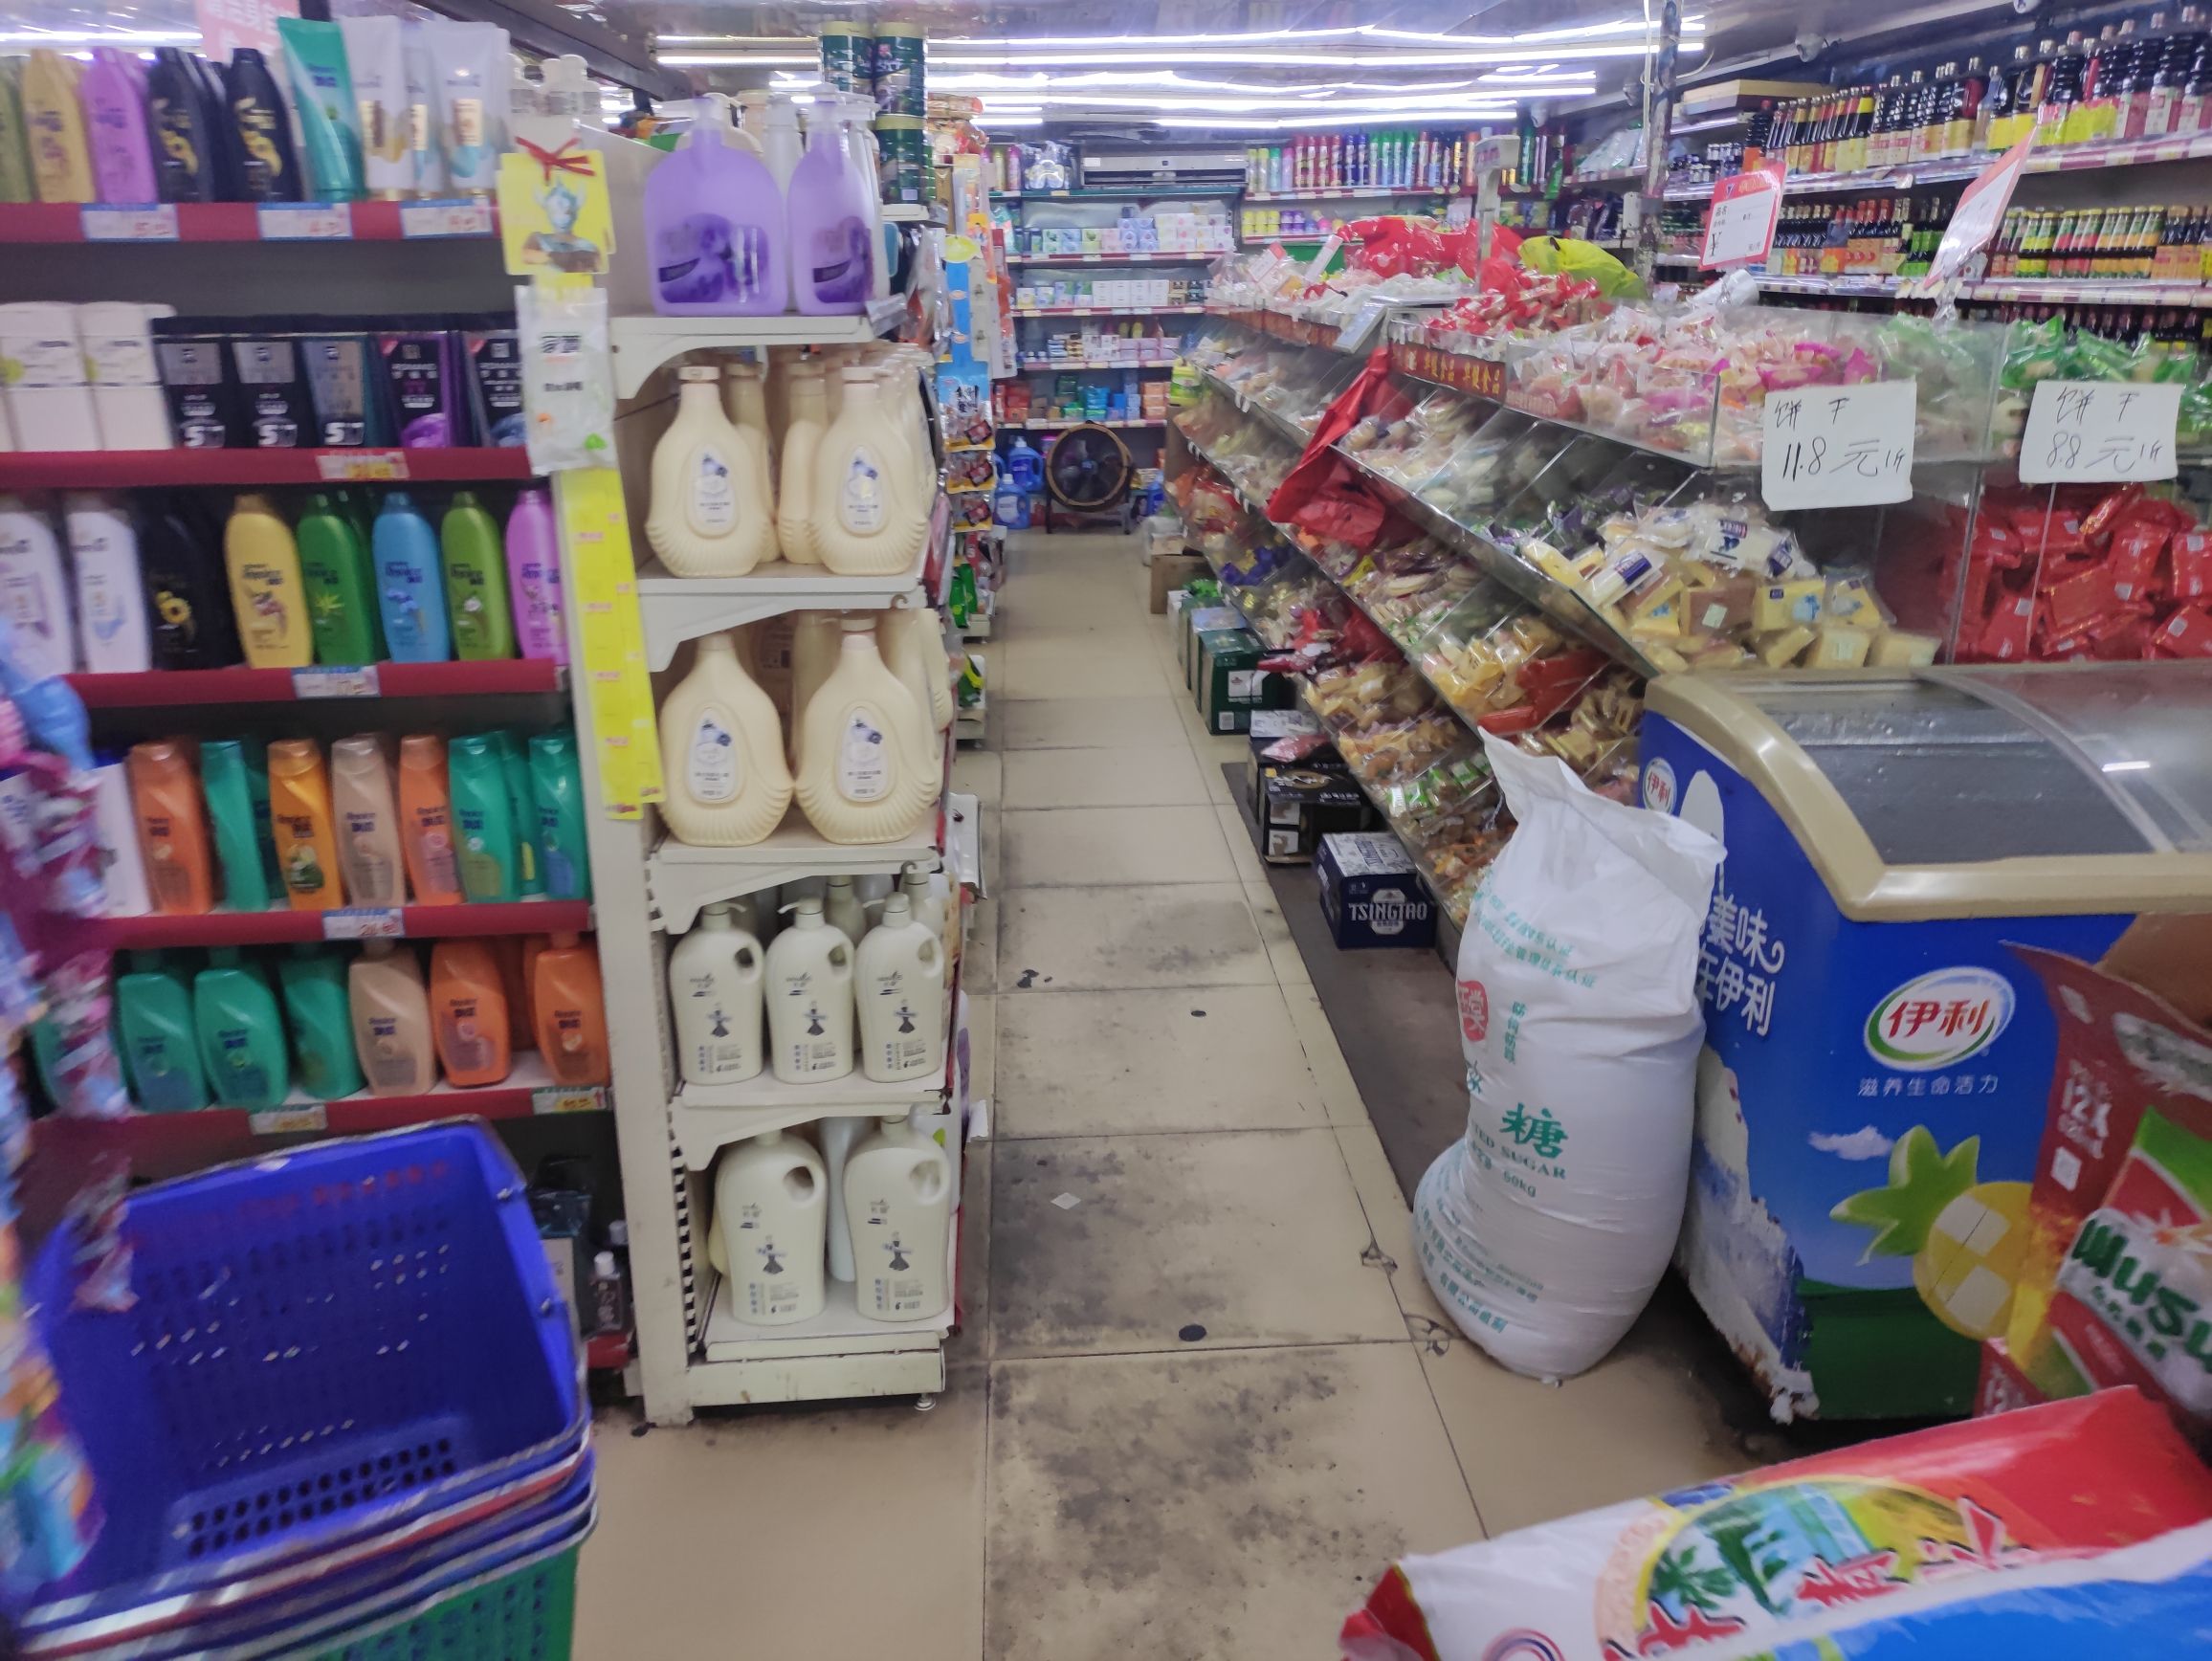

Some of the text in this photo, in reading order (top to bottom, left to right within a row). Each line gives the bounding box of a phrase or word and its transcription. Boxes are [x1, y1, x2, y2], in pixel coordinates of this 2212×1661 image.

[1888, 999, 1991, 1039] 伊利
[1857, 1074, 2000, 1097] 滋养生命活力
[1498, 1101, 1569, 1160] 糖
[1500, 1145, 1567, 1180] SUGAR
